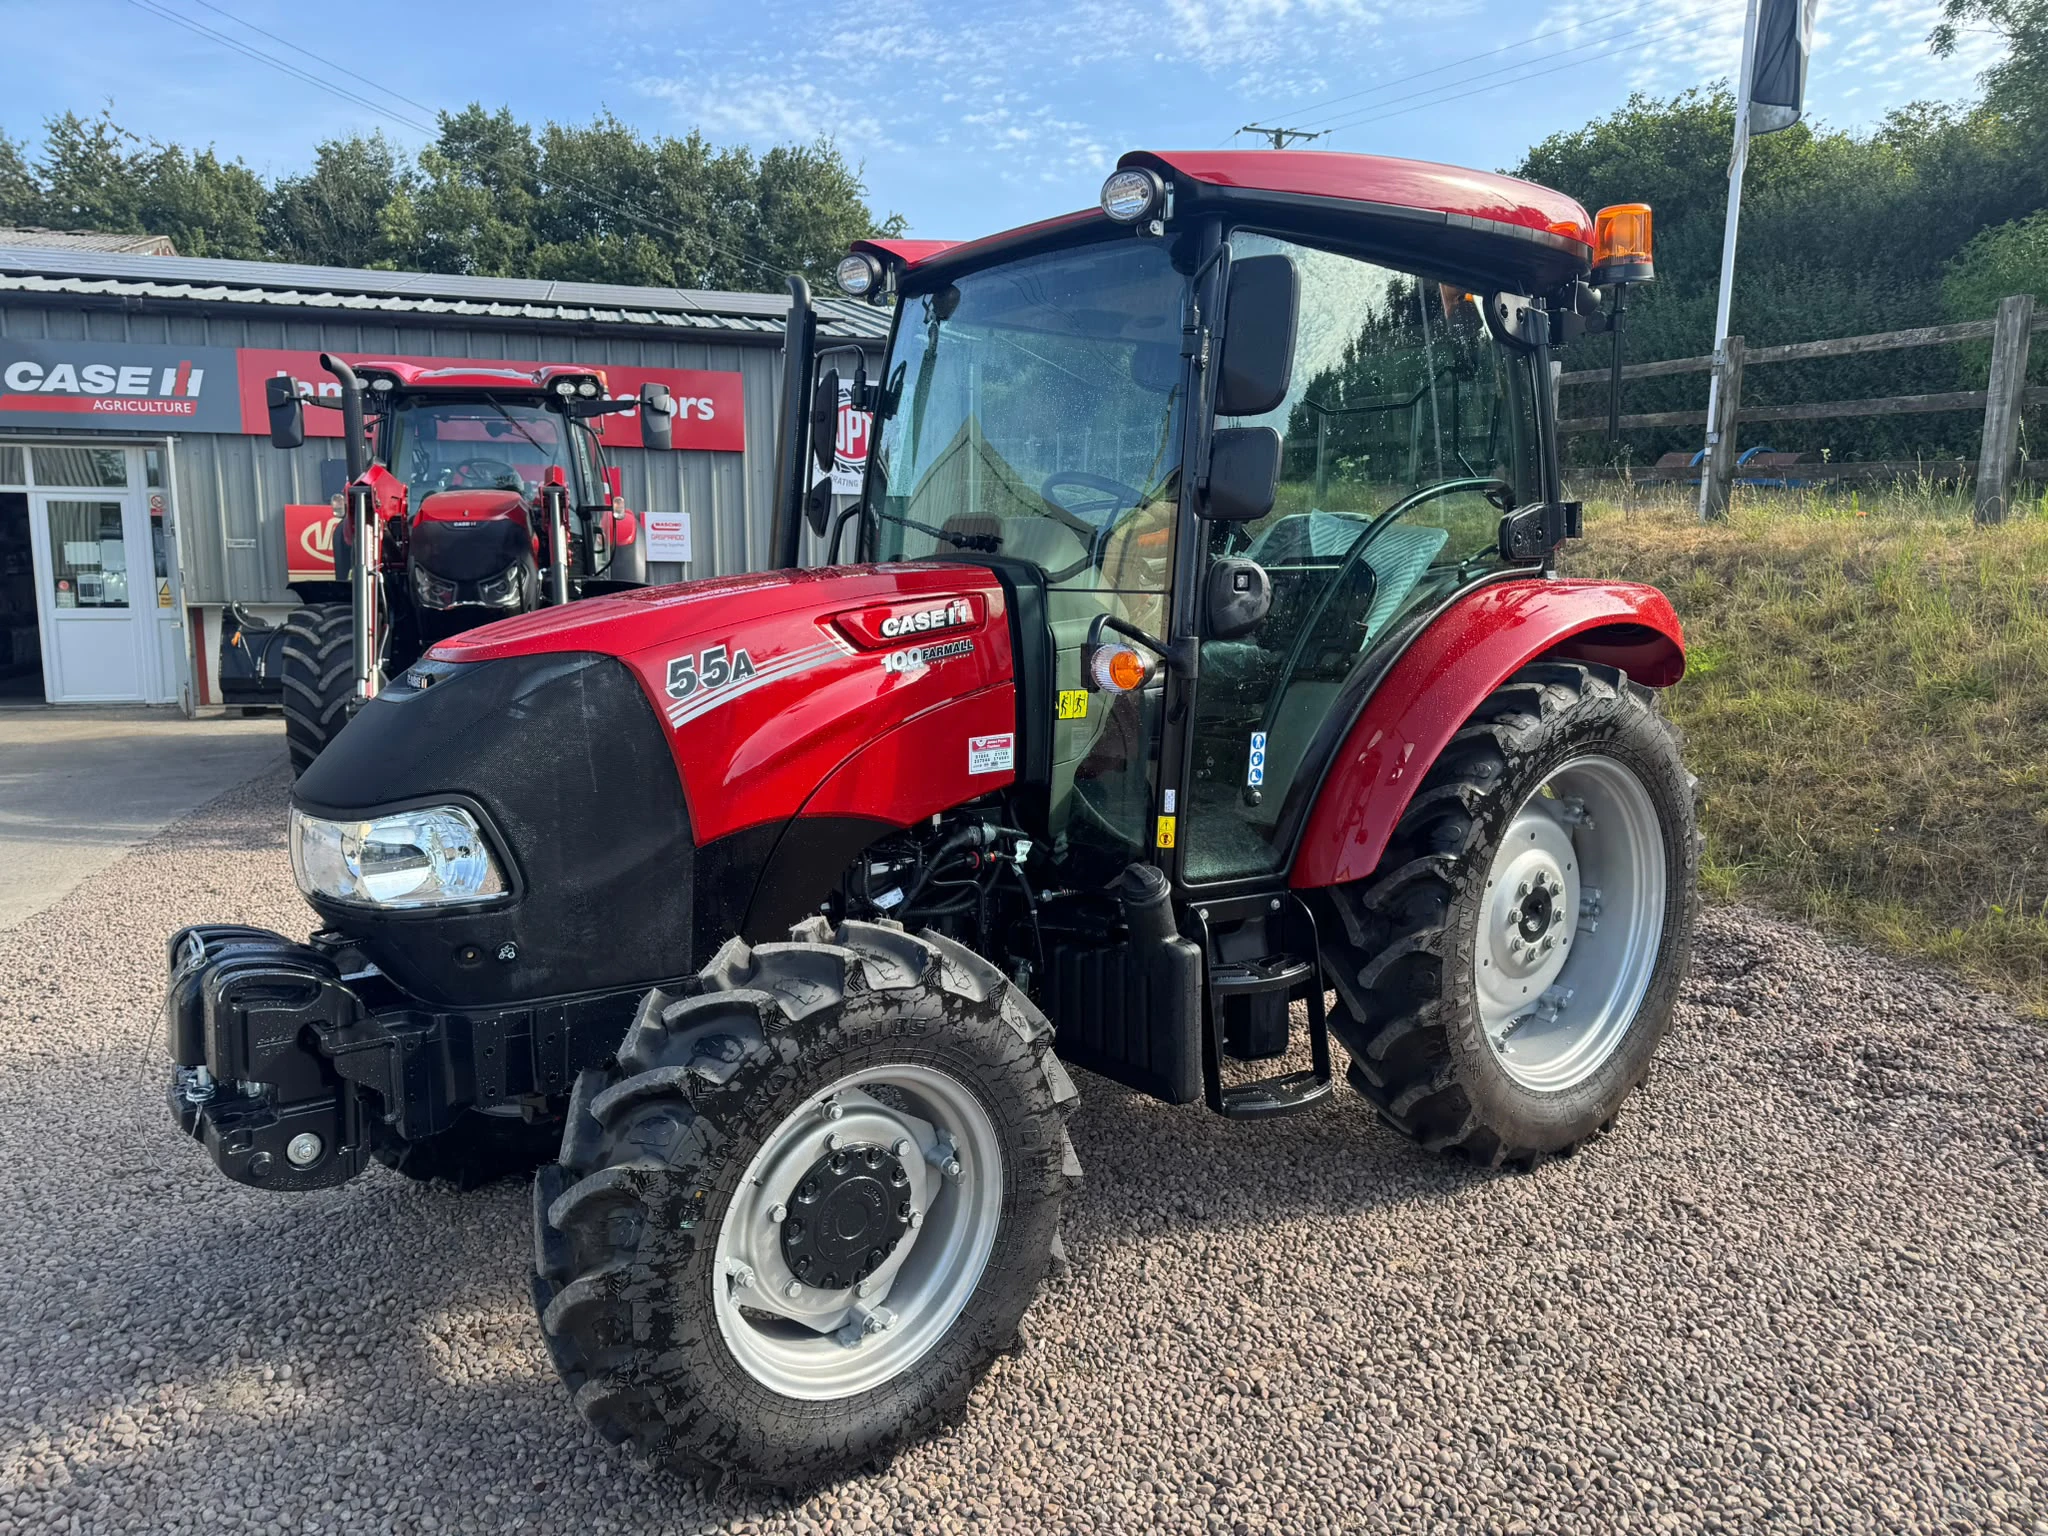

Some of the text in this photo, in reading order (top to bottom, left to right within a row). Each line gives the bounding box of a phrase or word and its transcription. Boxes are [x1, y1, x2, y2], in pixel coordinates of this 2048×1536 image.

[4, 360, 204, 397] CASE IH
[93, 400, 192, 414] AGRICULTURE
[881, 609, 945, 637] CASE
[665, 643, 758, 699] 55A
[881, 647, 922, 672] 100
[922, 638, 975, 660] FARMALL
[798, 1018, 883, 1069] Radial
